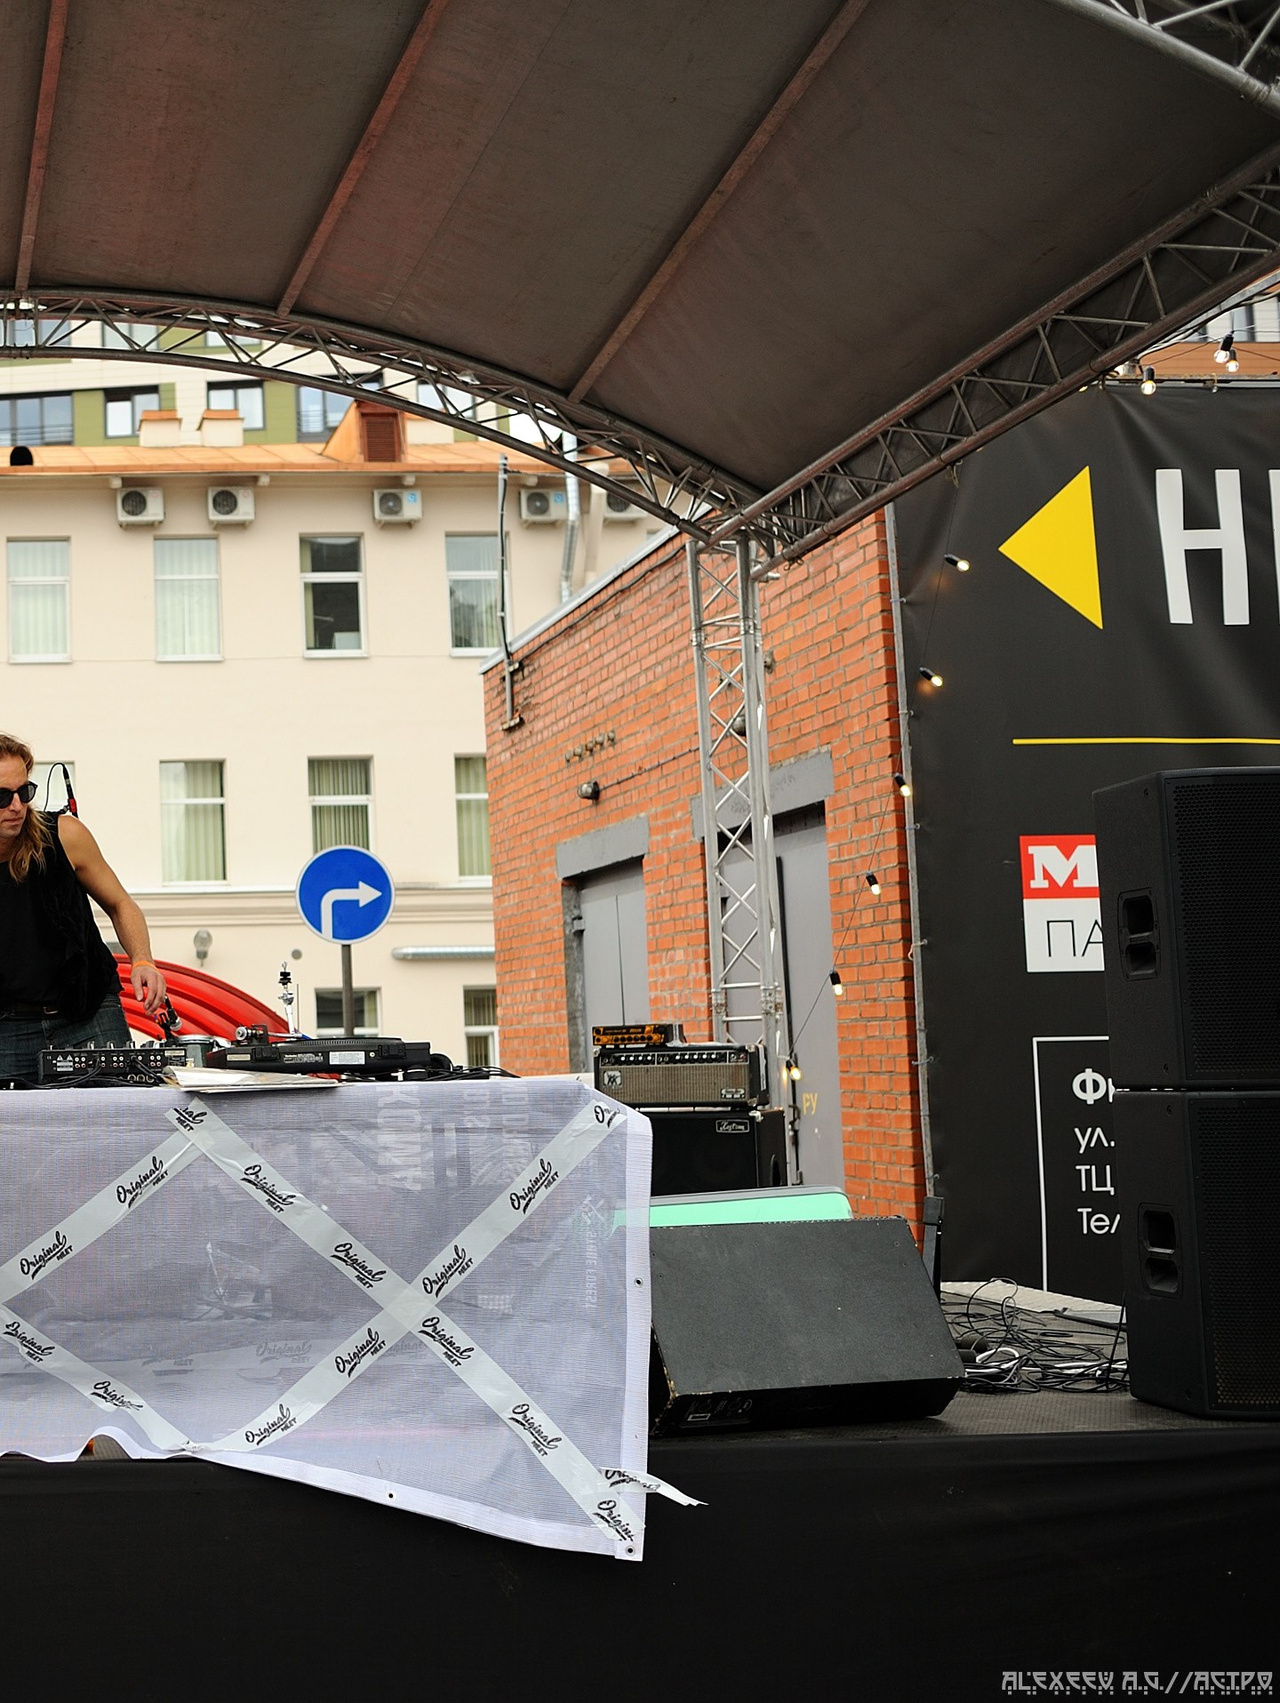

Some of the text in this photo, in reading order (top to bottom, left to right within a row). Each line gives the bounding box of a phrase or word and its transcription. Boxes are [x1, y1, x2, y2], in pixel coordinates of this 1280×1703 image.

[1156, 469, 1280, 626] Н
[1074, 1127, 1115, 1154] ул.
[115, 1155, 164, 1209] Original
[240, 1164, 297, 1206] Original
[510, 1158, 552, 1215] Original
[1076, 1165, 1114, 1195] ТЦ
[20, 1230, 67, 1280] Original
[330, 1242, 387, 1282] Original
[422, 1244, 467, 1298] Original
[335, 1327, 379, 1378] Original
[418, 1316, 475, 1360] Original
[245, 1403, 291, 1445] Original
[508, 1403, 562, 1450] Original
